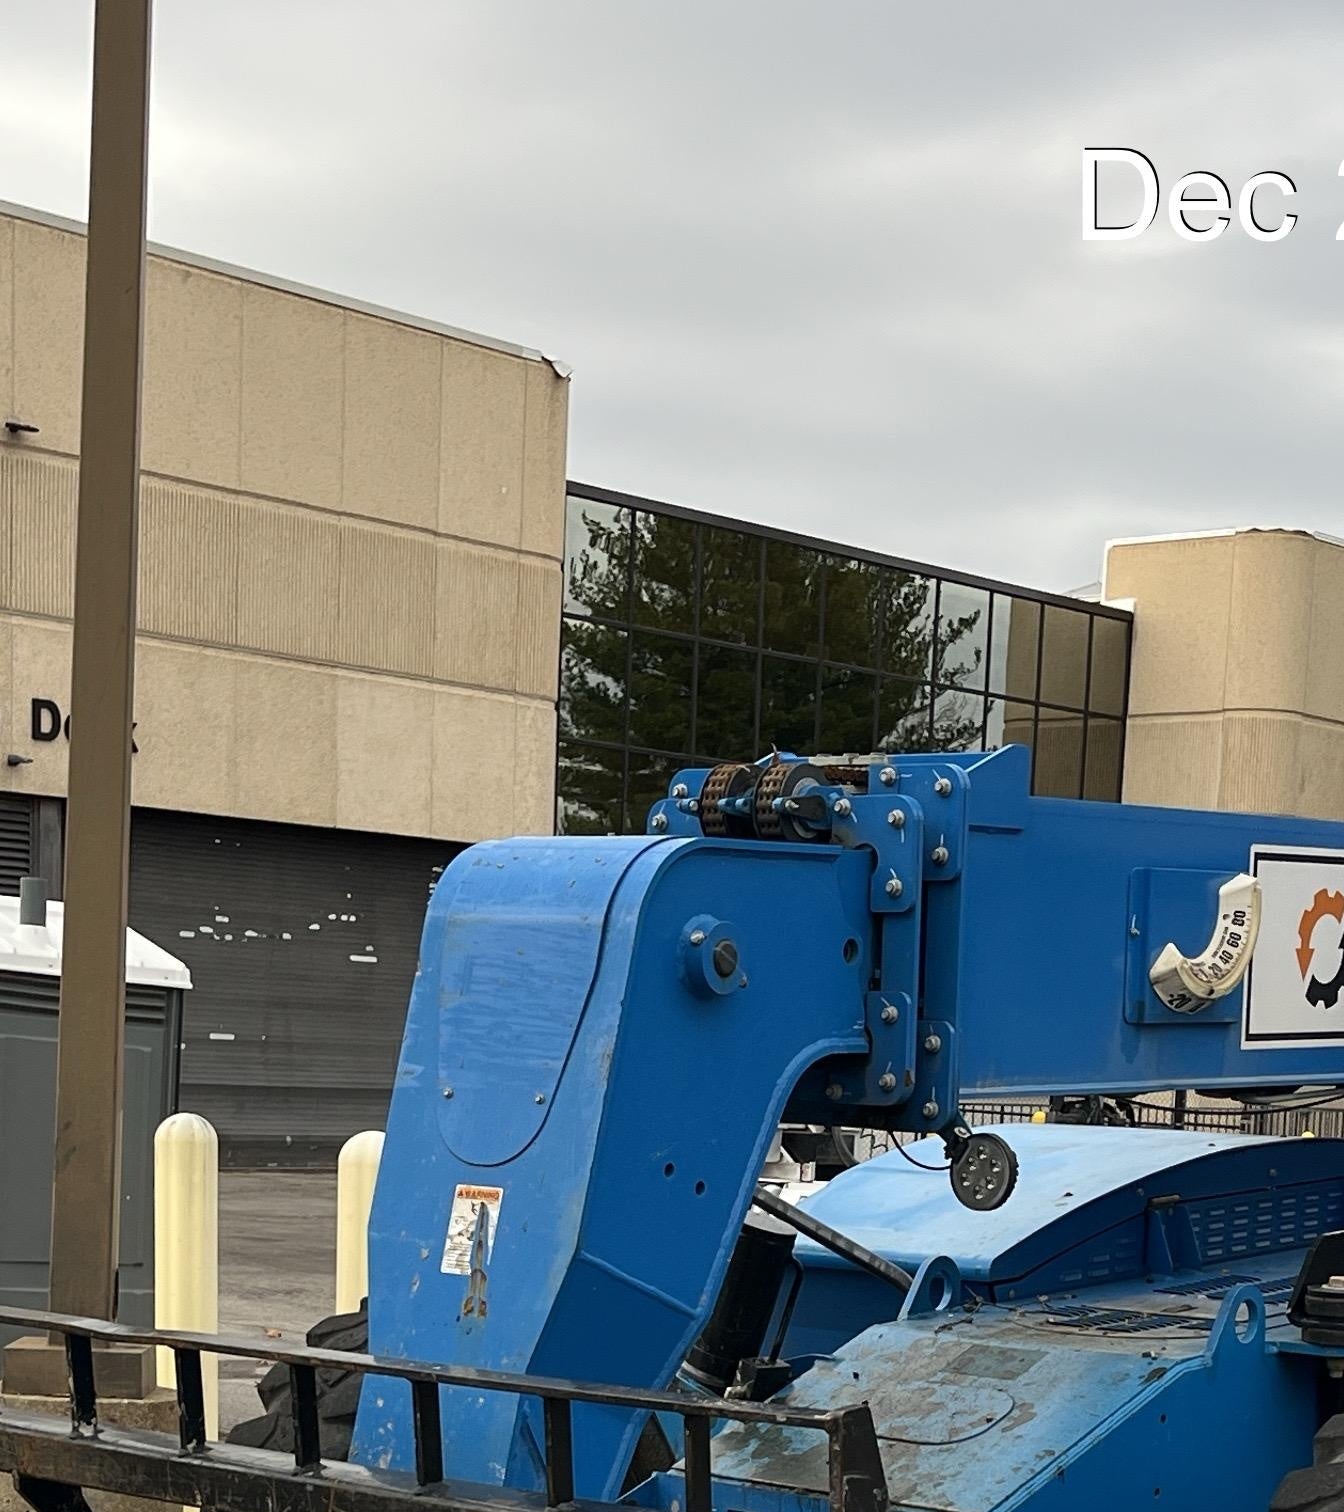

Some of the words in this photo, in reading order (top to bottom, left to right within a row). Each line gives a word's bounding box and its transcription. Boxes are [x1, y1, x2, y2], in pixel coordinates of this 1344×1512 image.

[1231, 910, 1246, 927] 80
[1226, 931, 1242, 948] 60
[1218, 949, 1234, 965] 40
